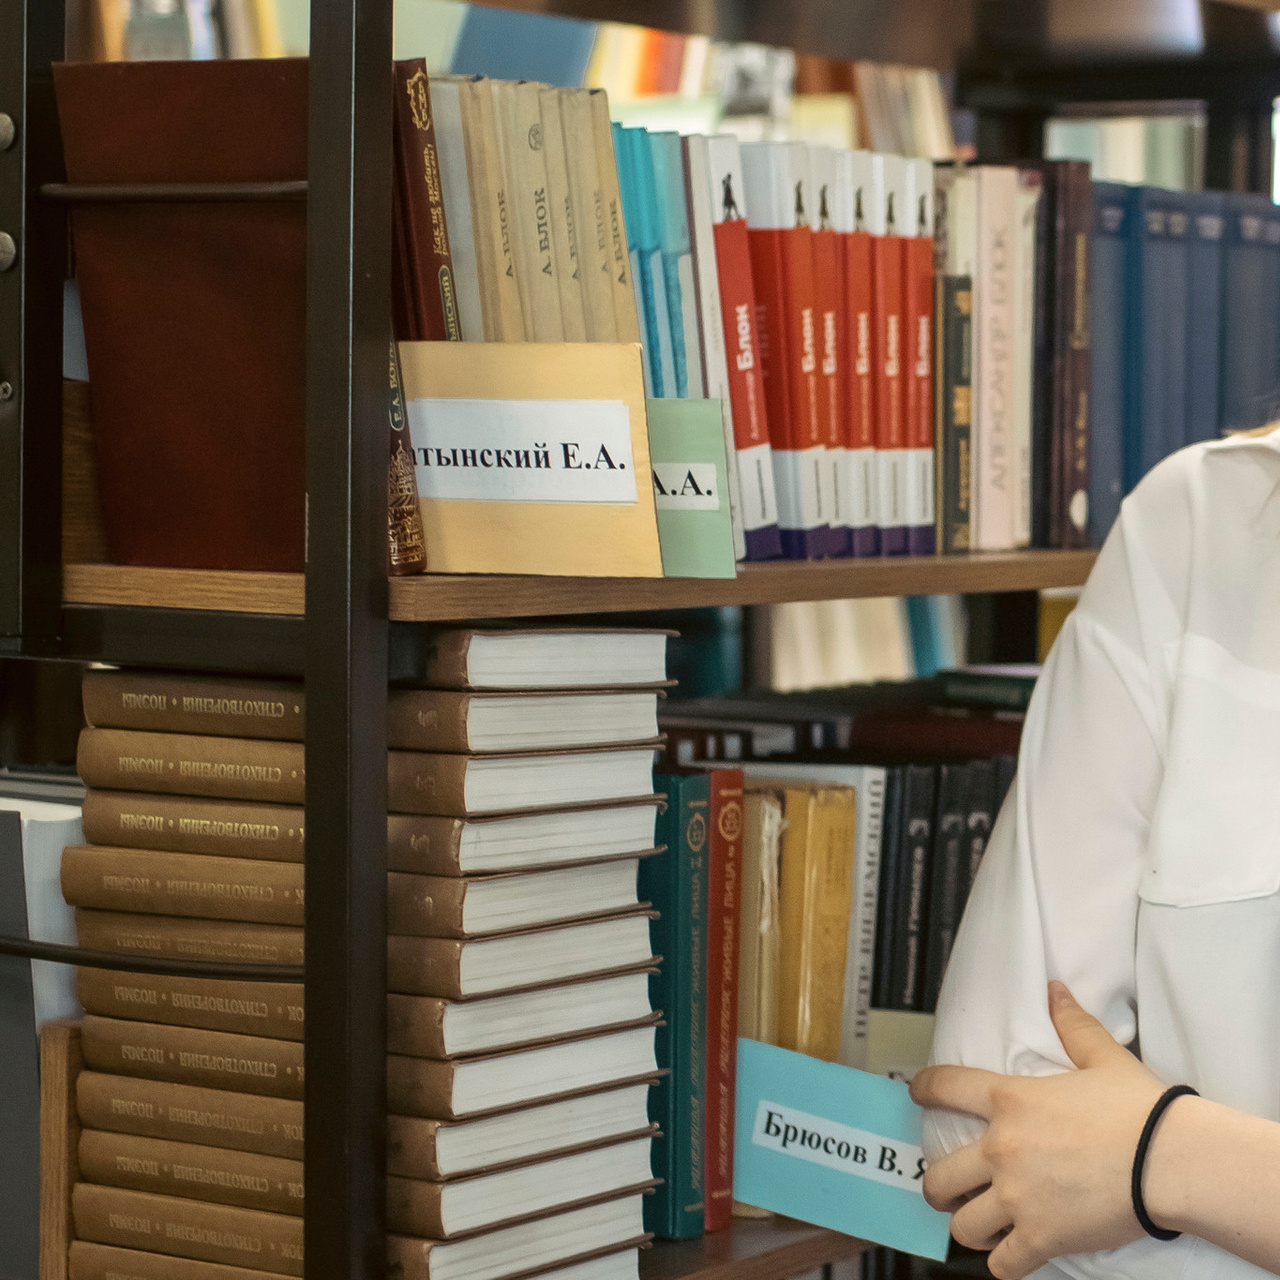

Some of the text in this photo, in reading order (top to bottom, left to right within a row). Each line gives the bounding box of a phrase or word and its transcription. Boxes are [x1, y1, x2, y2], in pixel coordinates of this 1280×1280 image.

[534, 187, 549, 253] БЛОК
[734, 303, 755, 371] Блок
[801, 308, 816, 374] Блок
[822, 311, 838, 376] Блок
[856, 311, 870, 375] Блок
[885, 314, 899, 377] Блок
[915, 315, 930, 378] Блок
[560, 442, 626, 469] Е.А.
[183, 696, 285, 718] СТИХОТВОРЕНИЯ
[763, 1110, 868, 1165] Брюсов
[878, 1145, 903, 1176] В.
